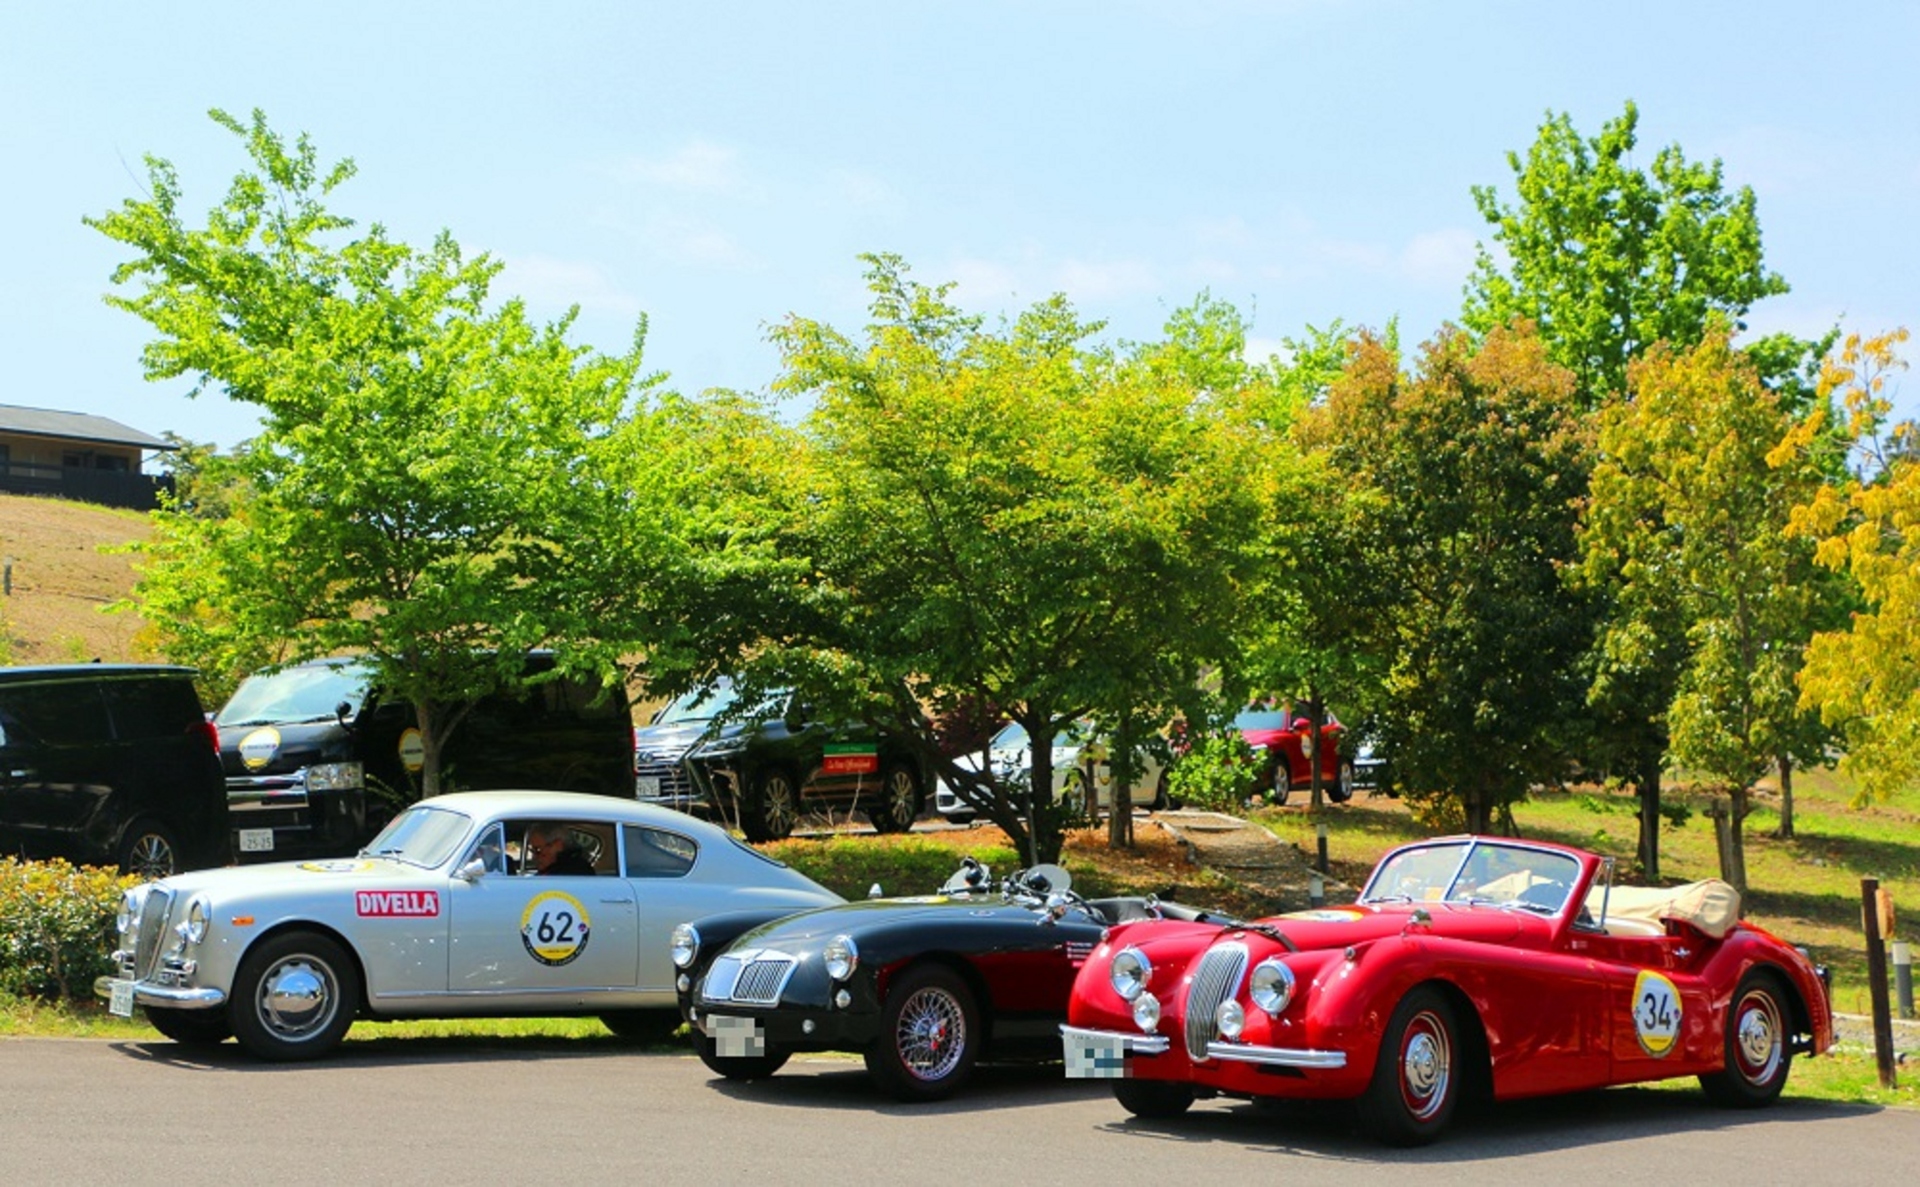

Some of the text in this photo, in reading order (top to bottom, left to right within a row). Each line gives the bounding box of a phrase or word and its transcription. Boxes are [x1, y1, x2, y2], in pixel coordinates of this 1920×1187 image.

[359, 893, 437, 913] DIVELLA
[537, 912, 573, 943] 62
[1643, 993, 1671, 1030] 34
